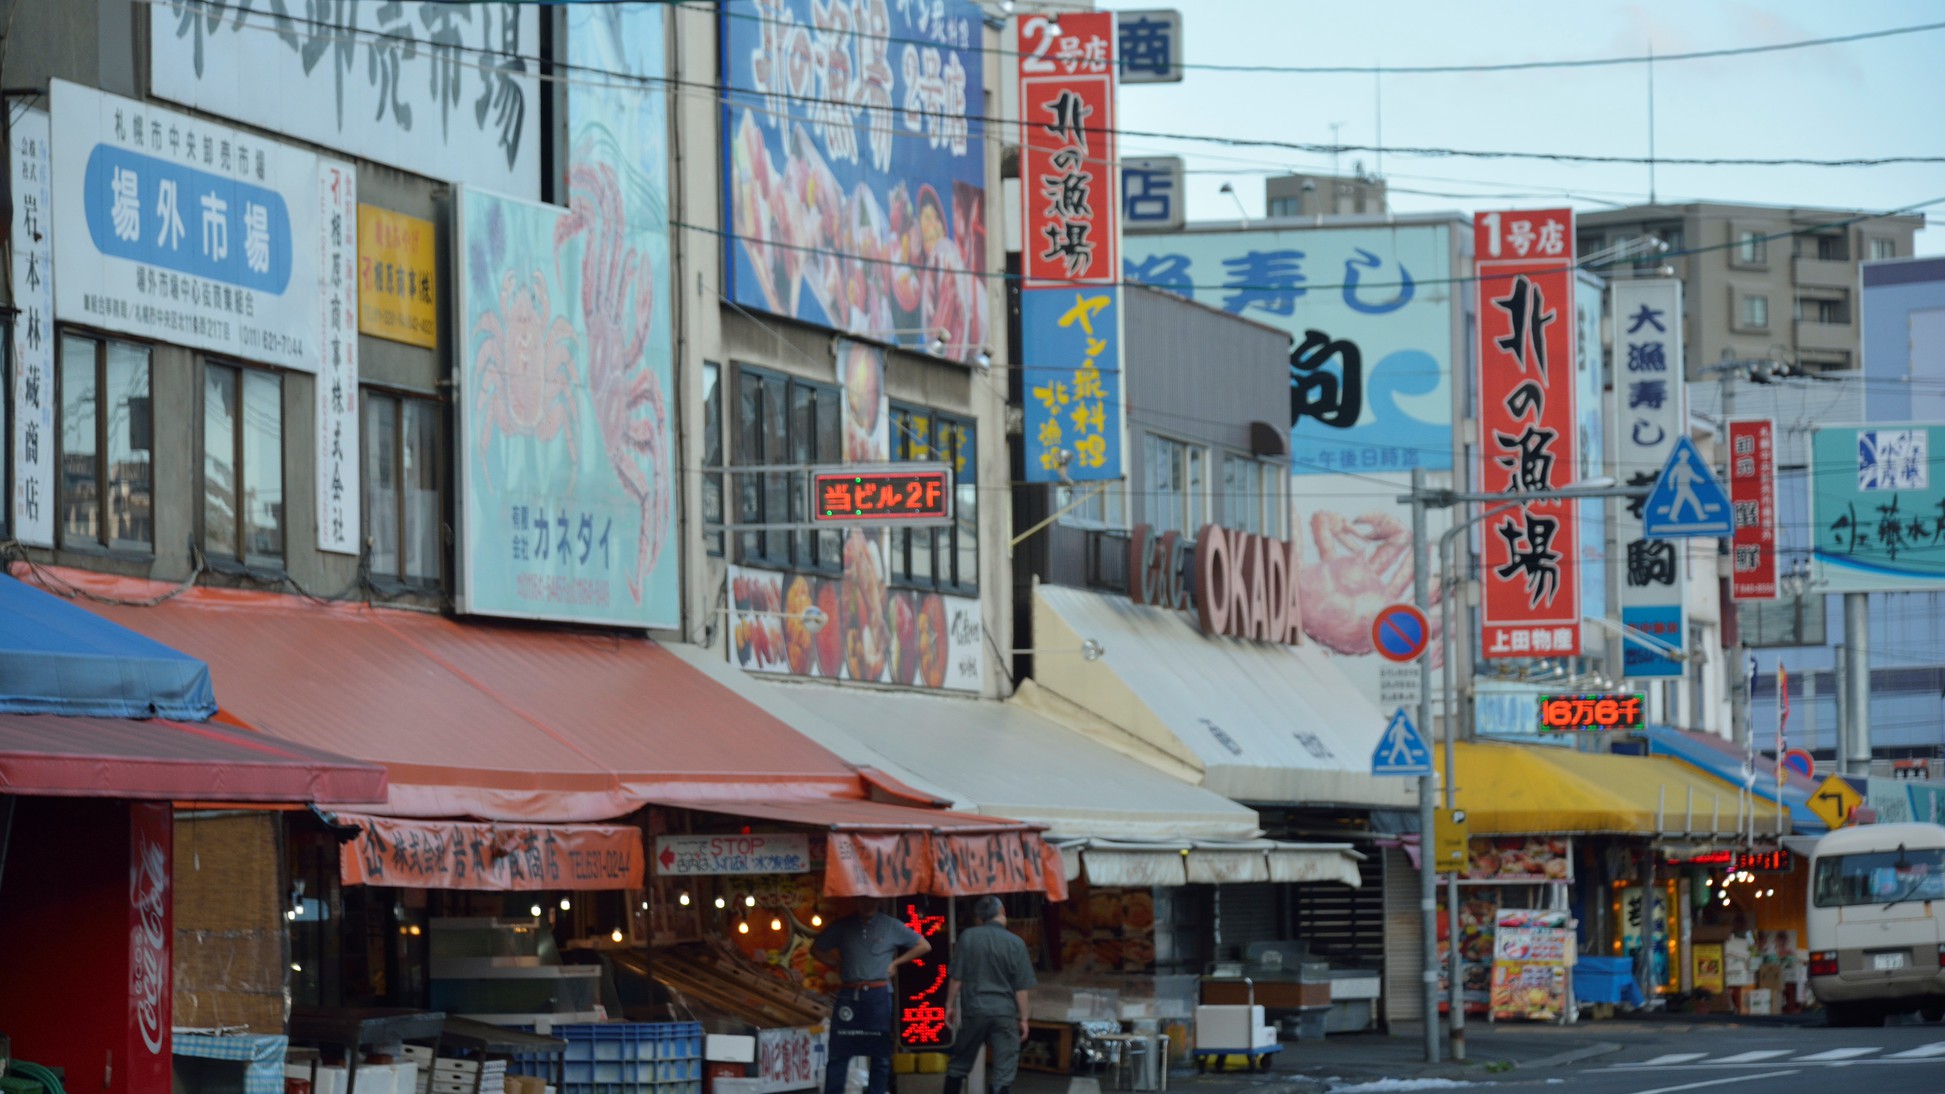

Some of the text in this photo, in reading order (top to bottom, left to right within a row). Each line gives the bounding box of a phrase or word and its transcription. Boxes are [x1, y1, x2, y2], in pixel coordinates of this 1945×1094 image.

[1022, 17, 1109, 74] 2号店
[114, 107, 267, 181] 札幌市中央卸売市場
[902, 43, 969, 157] 2号店
[111, 164, 271, 274] 場外市場
[1041, 88, 1097, 278] 北の漁場
[1482, 212, 1565, 257] 1号店
[1058, 293, 1113, 468] ヤン衆料理
[1627, 303, 1668, 447] 大漁寿し
[1490, 273, 1562, 612] 北の漁場
[533, 506, 613, 570] カネダイ
[823, 481, 942, 512] 当ビル2F
[1198, 523, 1305, 647] OKADA
[1490, 628, 1574, 653] 上田物産
[1542, 698, 1640, 727] 16万6千
[710, 836, 766, 856] STOP
[130, 826, 166, 1055] Coca-Cola
